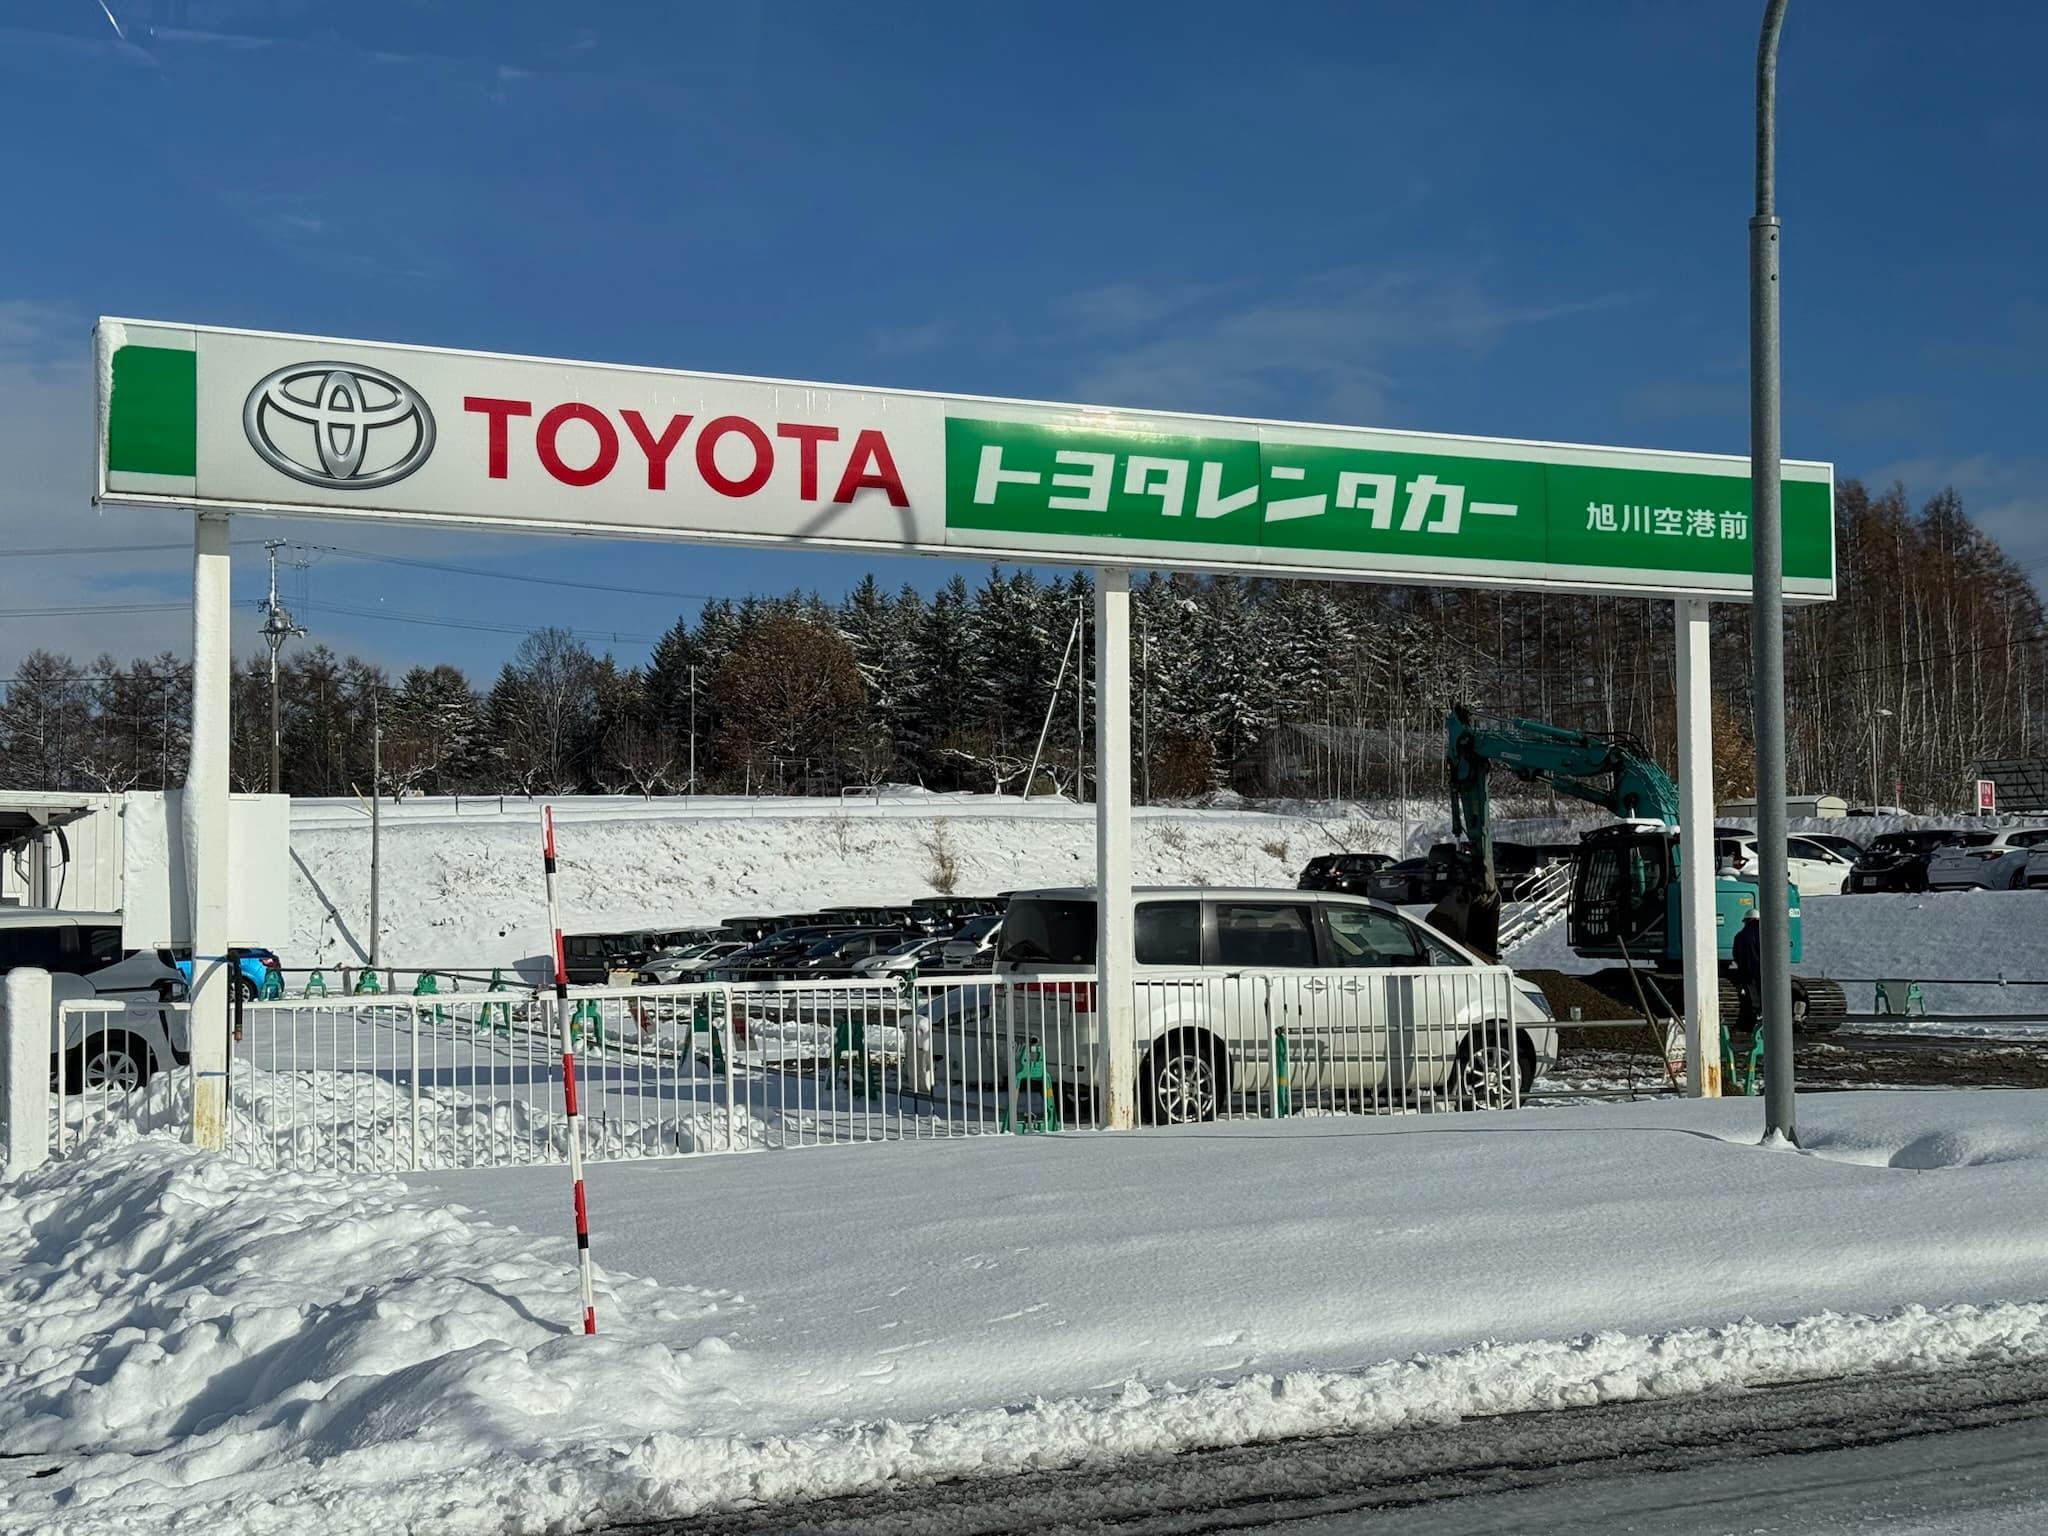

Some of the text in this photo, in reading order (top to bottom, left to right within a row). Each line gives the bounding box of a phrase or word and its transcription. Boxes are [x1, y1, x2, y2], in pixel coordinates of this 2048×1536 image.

[464, 396, 910, 508] TOYOTA
[973, 445, 1518, 534] トヨタレンタカー
[1586, 501, 1748, 541] 旭川空港前
